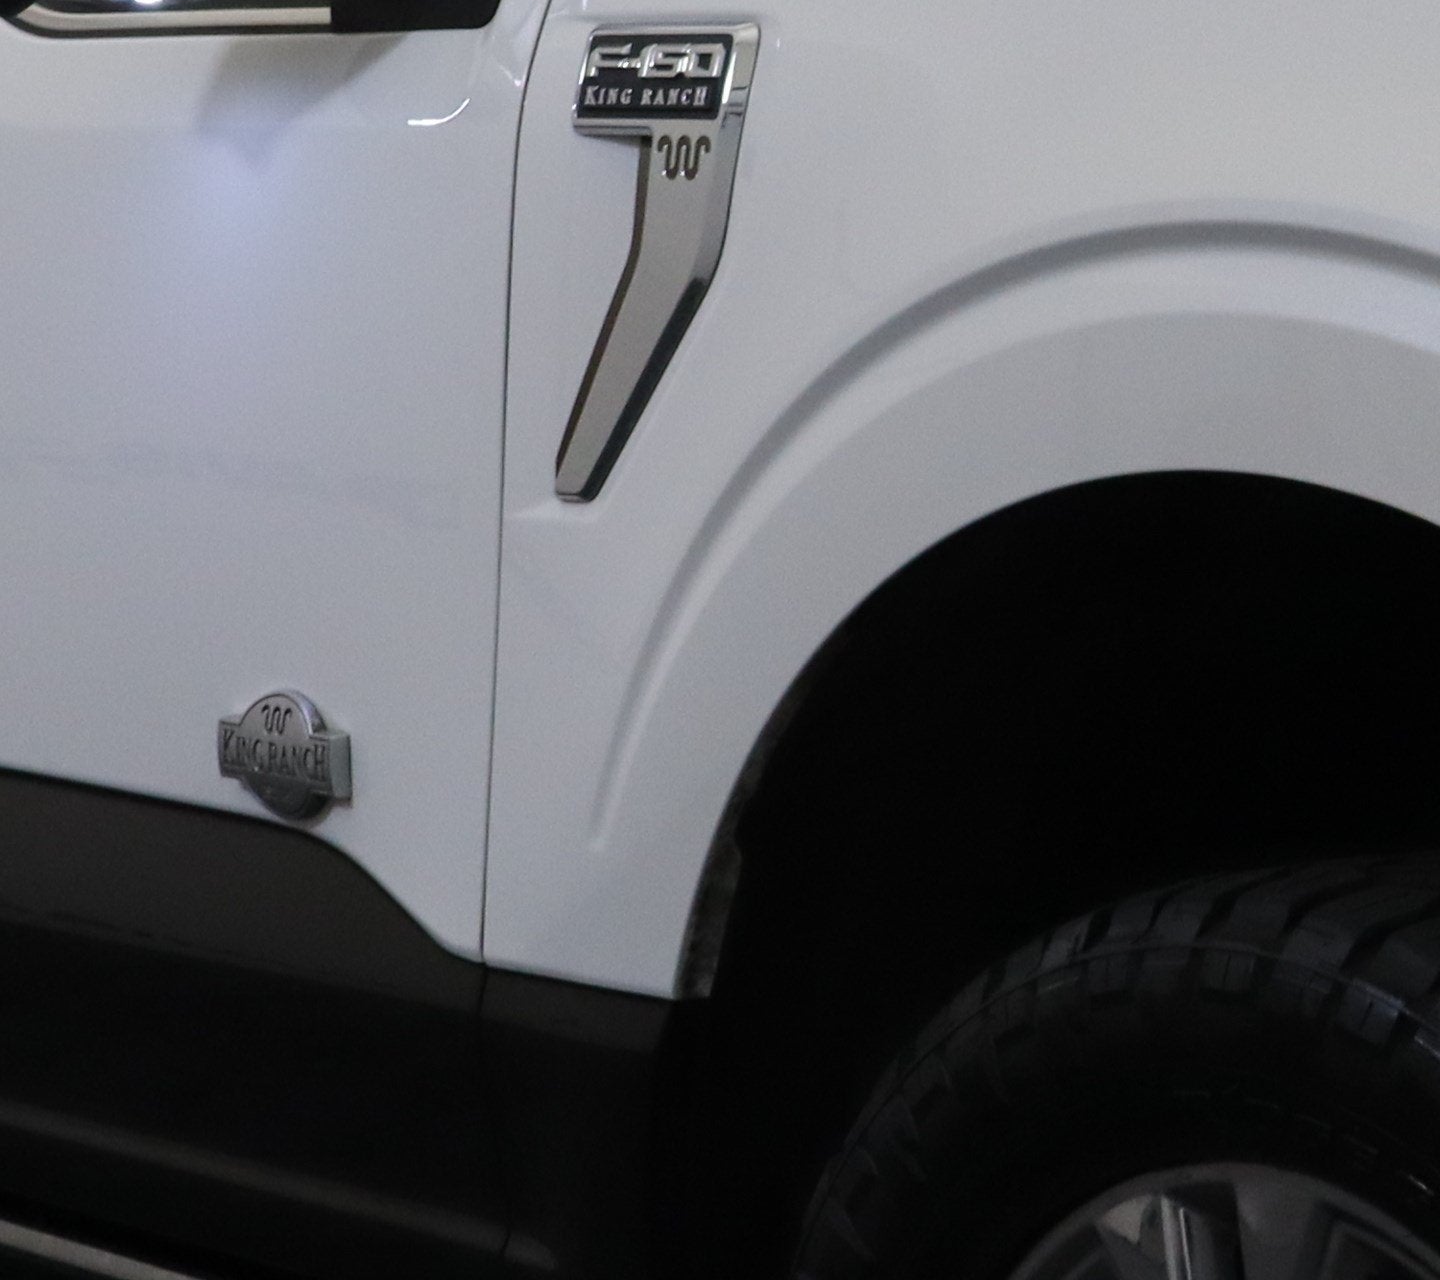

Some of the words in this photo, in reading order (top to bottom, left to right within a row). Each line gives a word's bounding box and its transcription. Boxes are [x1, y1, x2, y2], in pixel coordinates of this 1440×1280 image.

[586, 42, 727, 77] F-150
[584, 85, 633, 106] KING
[640, 85, 708, 107] RANCH
